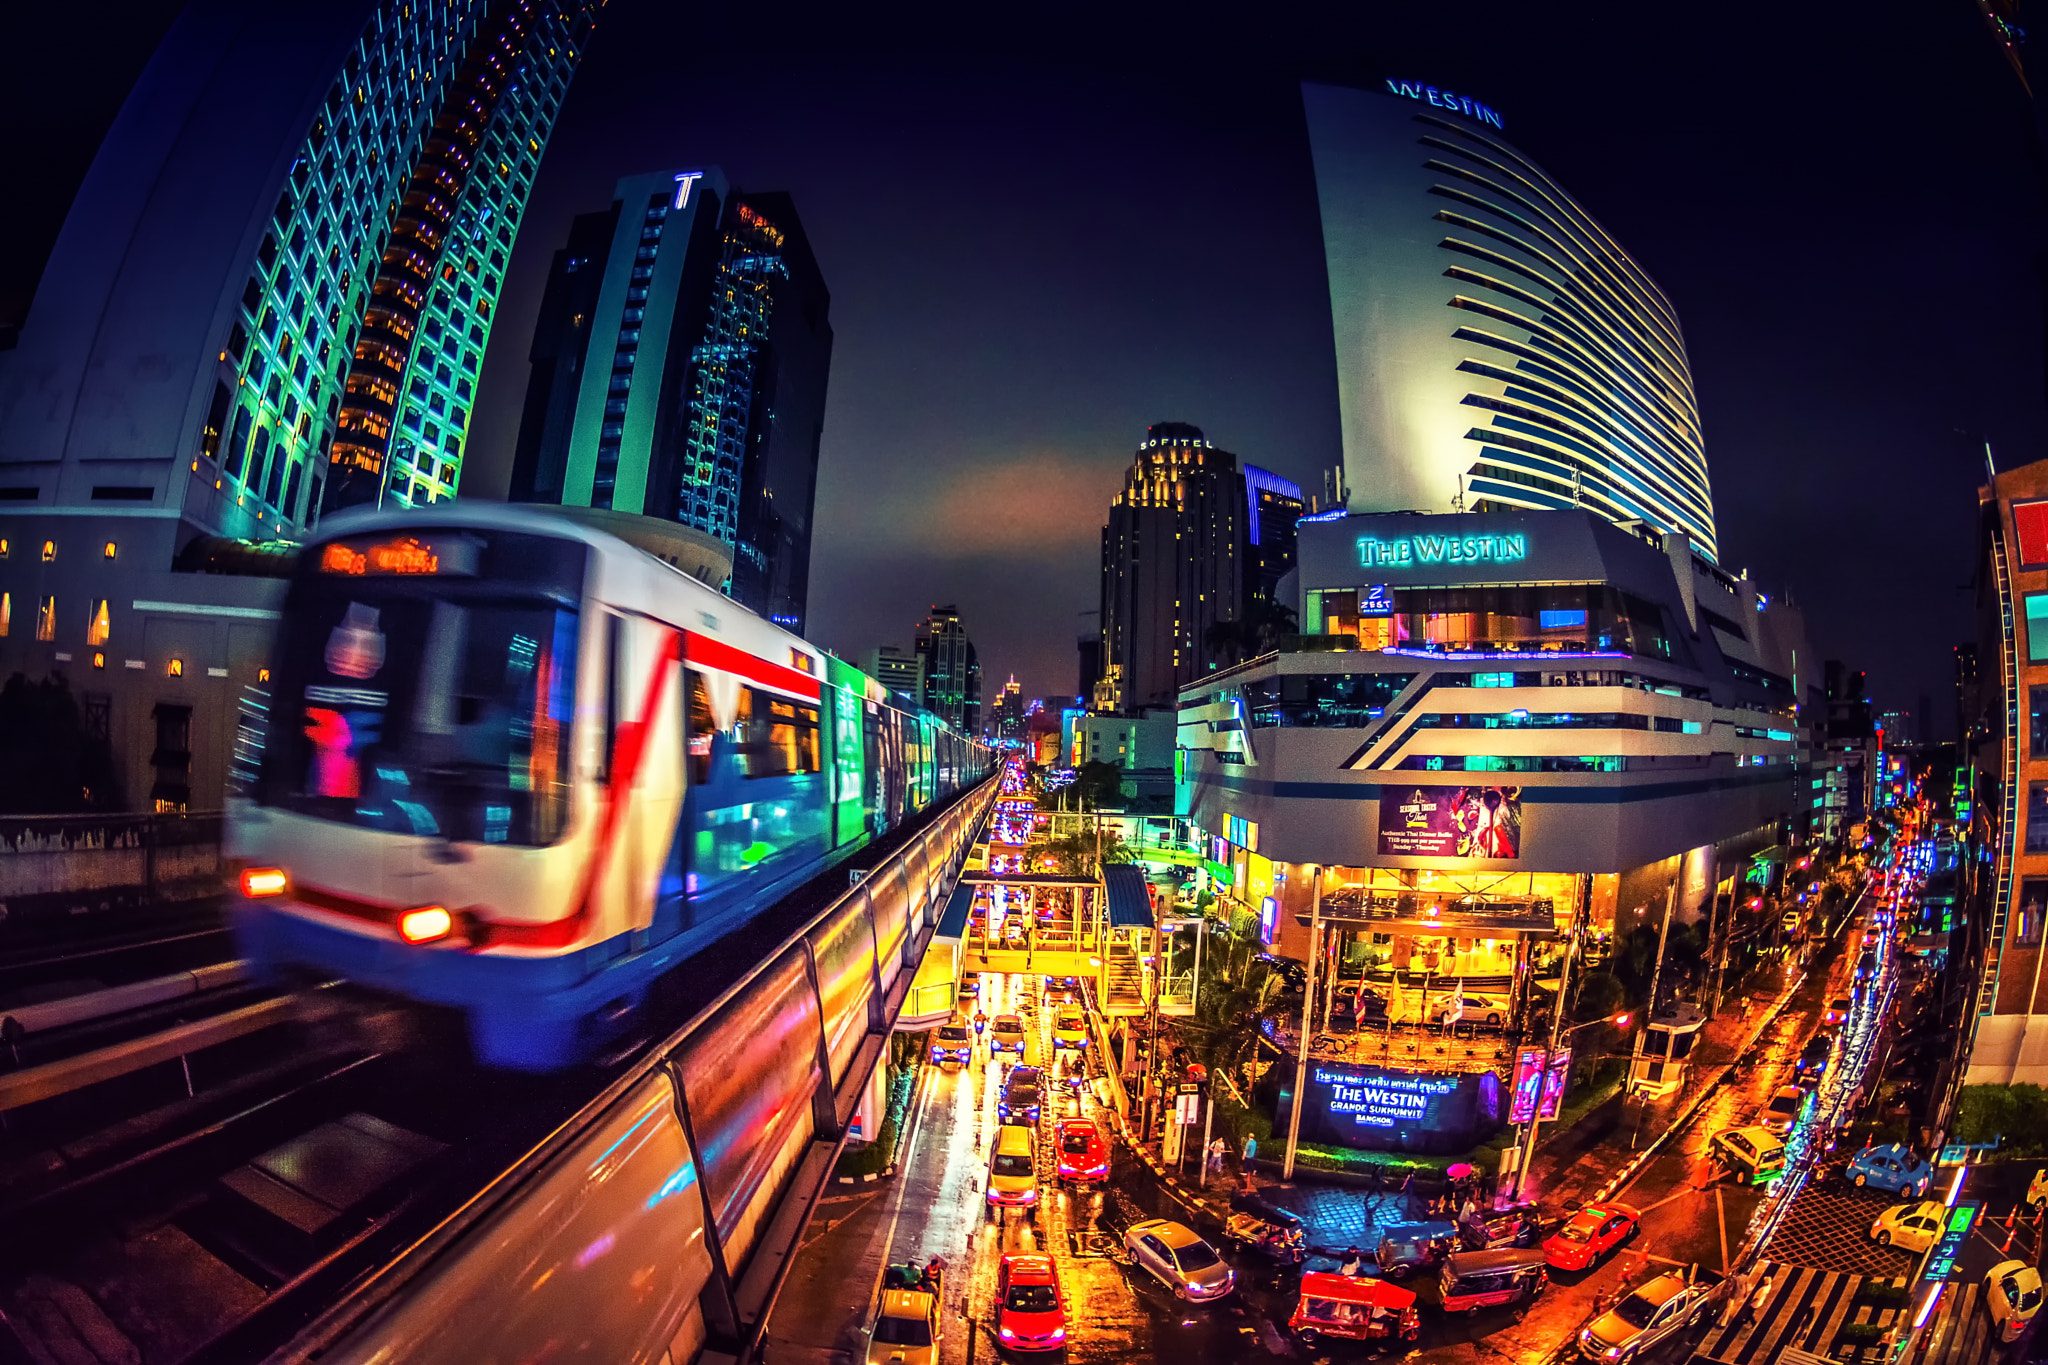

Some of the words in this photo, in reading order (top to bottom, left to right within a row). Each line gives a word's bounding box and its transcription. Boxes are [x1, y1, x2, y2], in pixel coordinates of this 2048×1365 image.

[1386, 78, 1503, 129] WESTIN
[675, 171, 703, 210] T
[1140, 438, 1213, 450] SOFITEL
[1358, 539, 1410, 563] THE
[1414, 535, 1525, 561] WESTIN
[1361, 600, 1391, 608] ZEST
[1332, 1084, 1362, 1101] THE
[1364, 1088, 1425, 1107] WESTIN
[1330, 1101, 1366, 1112] GRANDE
[1369, 1105, 1422, 1117] SUKHUMVIT
[1356, 1114, 1392, 1124] BANGKOK
